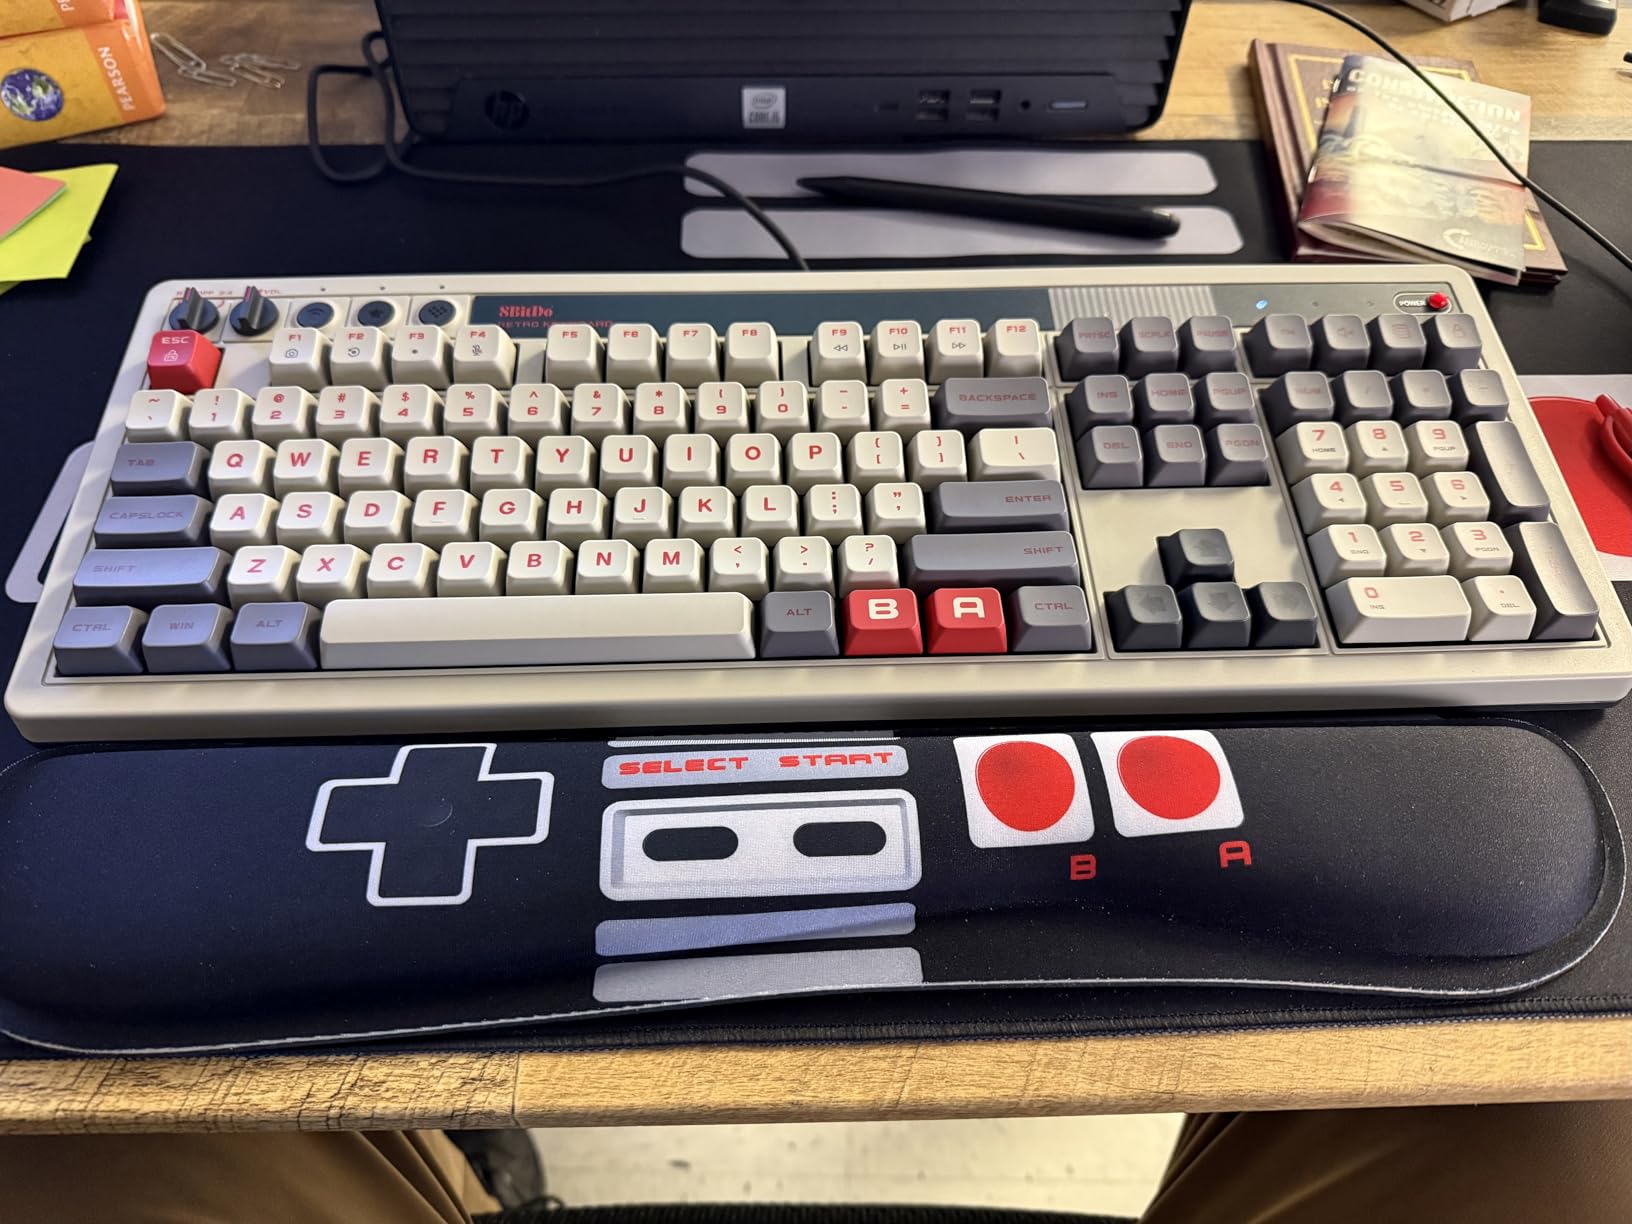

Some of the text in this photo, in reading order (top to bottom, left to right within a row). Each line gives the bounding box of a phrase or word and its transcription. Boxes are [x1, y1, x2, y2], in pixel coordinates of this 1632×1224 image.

[98, 46, 135, 111] PEARSON
[1399, 300, 1427, 308] POWER
[499, 305, 554, 319] 8BitDo
[160, 335, 191, 345] ESC
[214, 395, 220, 405] !
[273, 394, 284, 403] @
[337, 393, 346, 402] #
[401, 392, 410, 402] $
[592, 391, 601, 399] &
[959, 391, 1037, 402] BACKSPACE
[1097, 391, 1118, 399] INS
[398, 408, 408, 416] 4
[463, 408, 473, 416] 5
[528, 407, 538, 415] 6
[592, 407, 601, 415] 7
[654, 406, 664, 414] 8
[716, 405, 726, 414] 9
[778, 404, 788, 412] 0
[210, 412, 217, 421] 1
[270, 410, 281, 419] 2
[335, 410, 345, 419] 3
[1312, 429, 1325, 440] 7
[1373, 428, 1386, 439] 8
[1433, 428, 1446, 439] 9
[1166, 441, 1193, 449] END
[423, 449, 438, 463] R
[491, 449, 504, 463] T
[556, 448, 569, 463] Y
[619, 448, 633, 462] U
[687, 447, 692, 460] I
[745, 446, 761, 460] O
[809, 445, 822, 459] P
[227, 453, 243, 467] Q
[291, 452, 311, 466] W
[358, 451, 371, 466] E
[1330, 481, 1343, 491] 4
[1390, 480, 1404, 491] 5
[1451, 480, 1465, 490] 6
[433, 502, 446, 515] F
[499, 502, 515, 514] G
[567, 501, 582, 514] H
[634, 499, 646, 512] J
[698, 499, 712, 512] K
[764, 497, 776, 511] L
[230, 506, 245, 520] A
[297, 504, 312, 518] S
[364, 503, 380, 517] D
[109, 512, 184, 520] CAPSLOCK
[1348, 532, 1358, 543] 1
[1409, 531, 1424, 542] 2
[1472, 530, 1487, 540] 3
[865, 543, 874, 551] ?
[1023, 547, 1064, 555] SHIFT
[388, 557, 404, 570] C
[460, 555, 475, 568] V
[527, 554, 541, 567] B
[597, 552, 611, 565] N
[663, 551, 680, 565] M
[92, 564, 136, 573] SHIFT
[248, 559, 266, 573] Z
[318, 558, 334, 571] X
[1364, 587, 1379, 599] 0
[787, 608, 812, 616] ALT
[867, 598, 899, 620] B
[952, 596, 985, 619] A
[71, 623, 111, 632] CTRL
[618, 751, 894, 776] SELECT START
[1218, 840, 1252, 869] A
[1069, 853, 1097, 881] B
